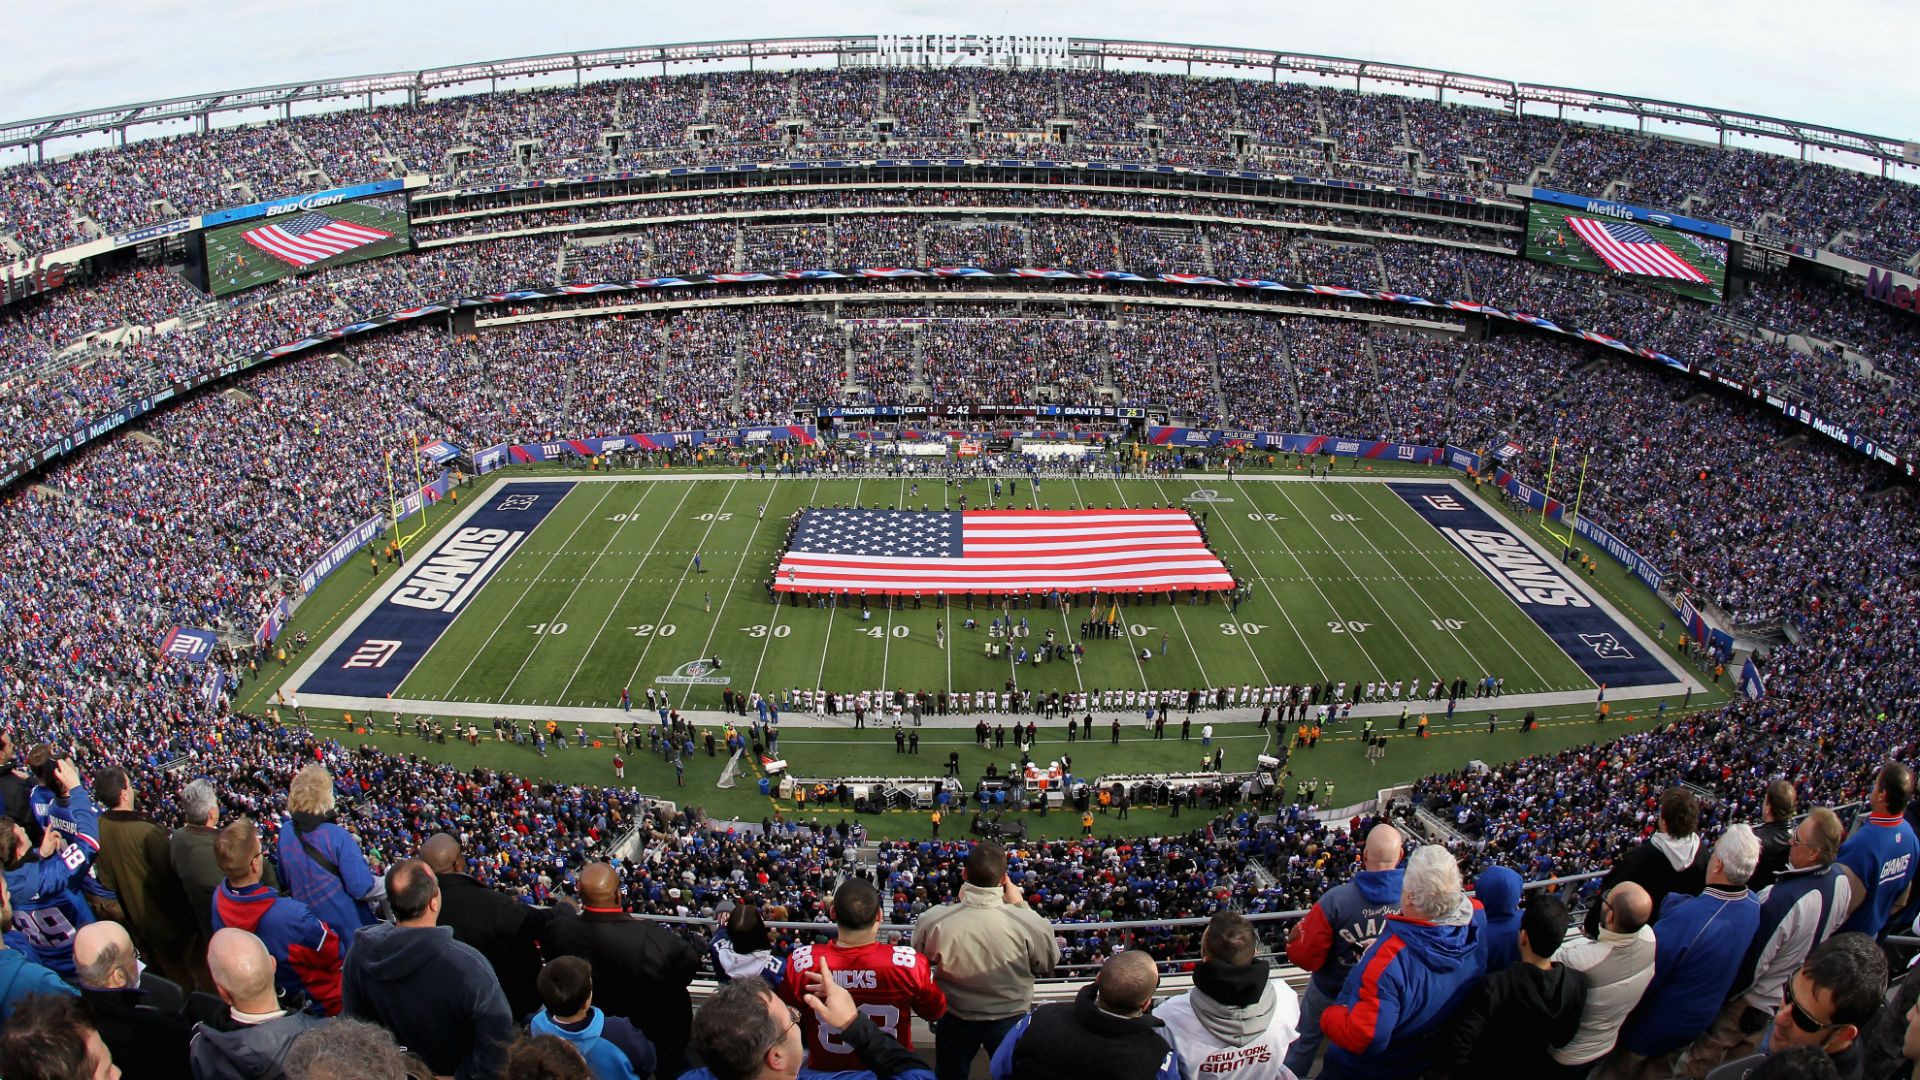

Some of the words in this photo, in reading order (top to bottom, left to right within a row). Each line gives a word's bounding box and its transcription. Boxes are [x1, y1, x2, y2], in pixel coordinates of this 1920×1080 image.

[265, 202, 299, 217] BUD
[306, 193, 346, 210] LIGHT
[1586, 201, 1635, 220] MetLife
[841, 407, 875, 415] FALCONS
[947, 405, 970, 415] 2:42
[1065, 407, 1101, 415] GIANTS
[1789, 405, 1796, 417] 0
[89, 413, 125, 440] MetLife
[1813, 417, 1849, 444] MetLife
[64, 438, 72, 451] 0
[1335, 442, 1359, 452] GIANTS
[1866, 442, 1872, 455] 0
[1590, 525, 1608, 547] YORK
[1607, 538, 1638, 570] FOOTBALL
[1638, 561, 1660, 589] GIANTS
[390, 527, 510, 610] GIANTS
[1456, 528, 1591, 608] GIANTS
[532, 622, 569, 635] 10
[634, 624, 677, 637] 20
[748, 624, 791, 638] 30
[866, 625, 910, 638] 40
[1219, 621, 1260, 636] 30
[1327, 620, 1367, 634] 20
[1430, 618, 1462, 631] 10
[1879, 853, 1911, 879] GIANTS
[1362, 908, 1381, 918] New
[792, 945, 814, 973] 88
[892, 945, 916, 968] 88
[1206, 1052, 1235, 1063] NEW
[1238, 1044, 1268, 1058] YORK
[1199, 1052, 1272, 1074] GIANTS
